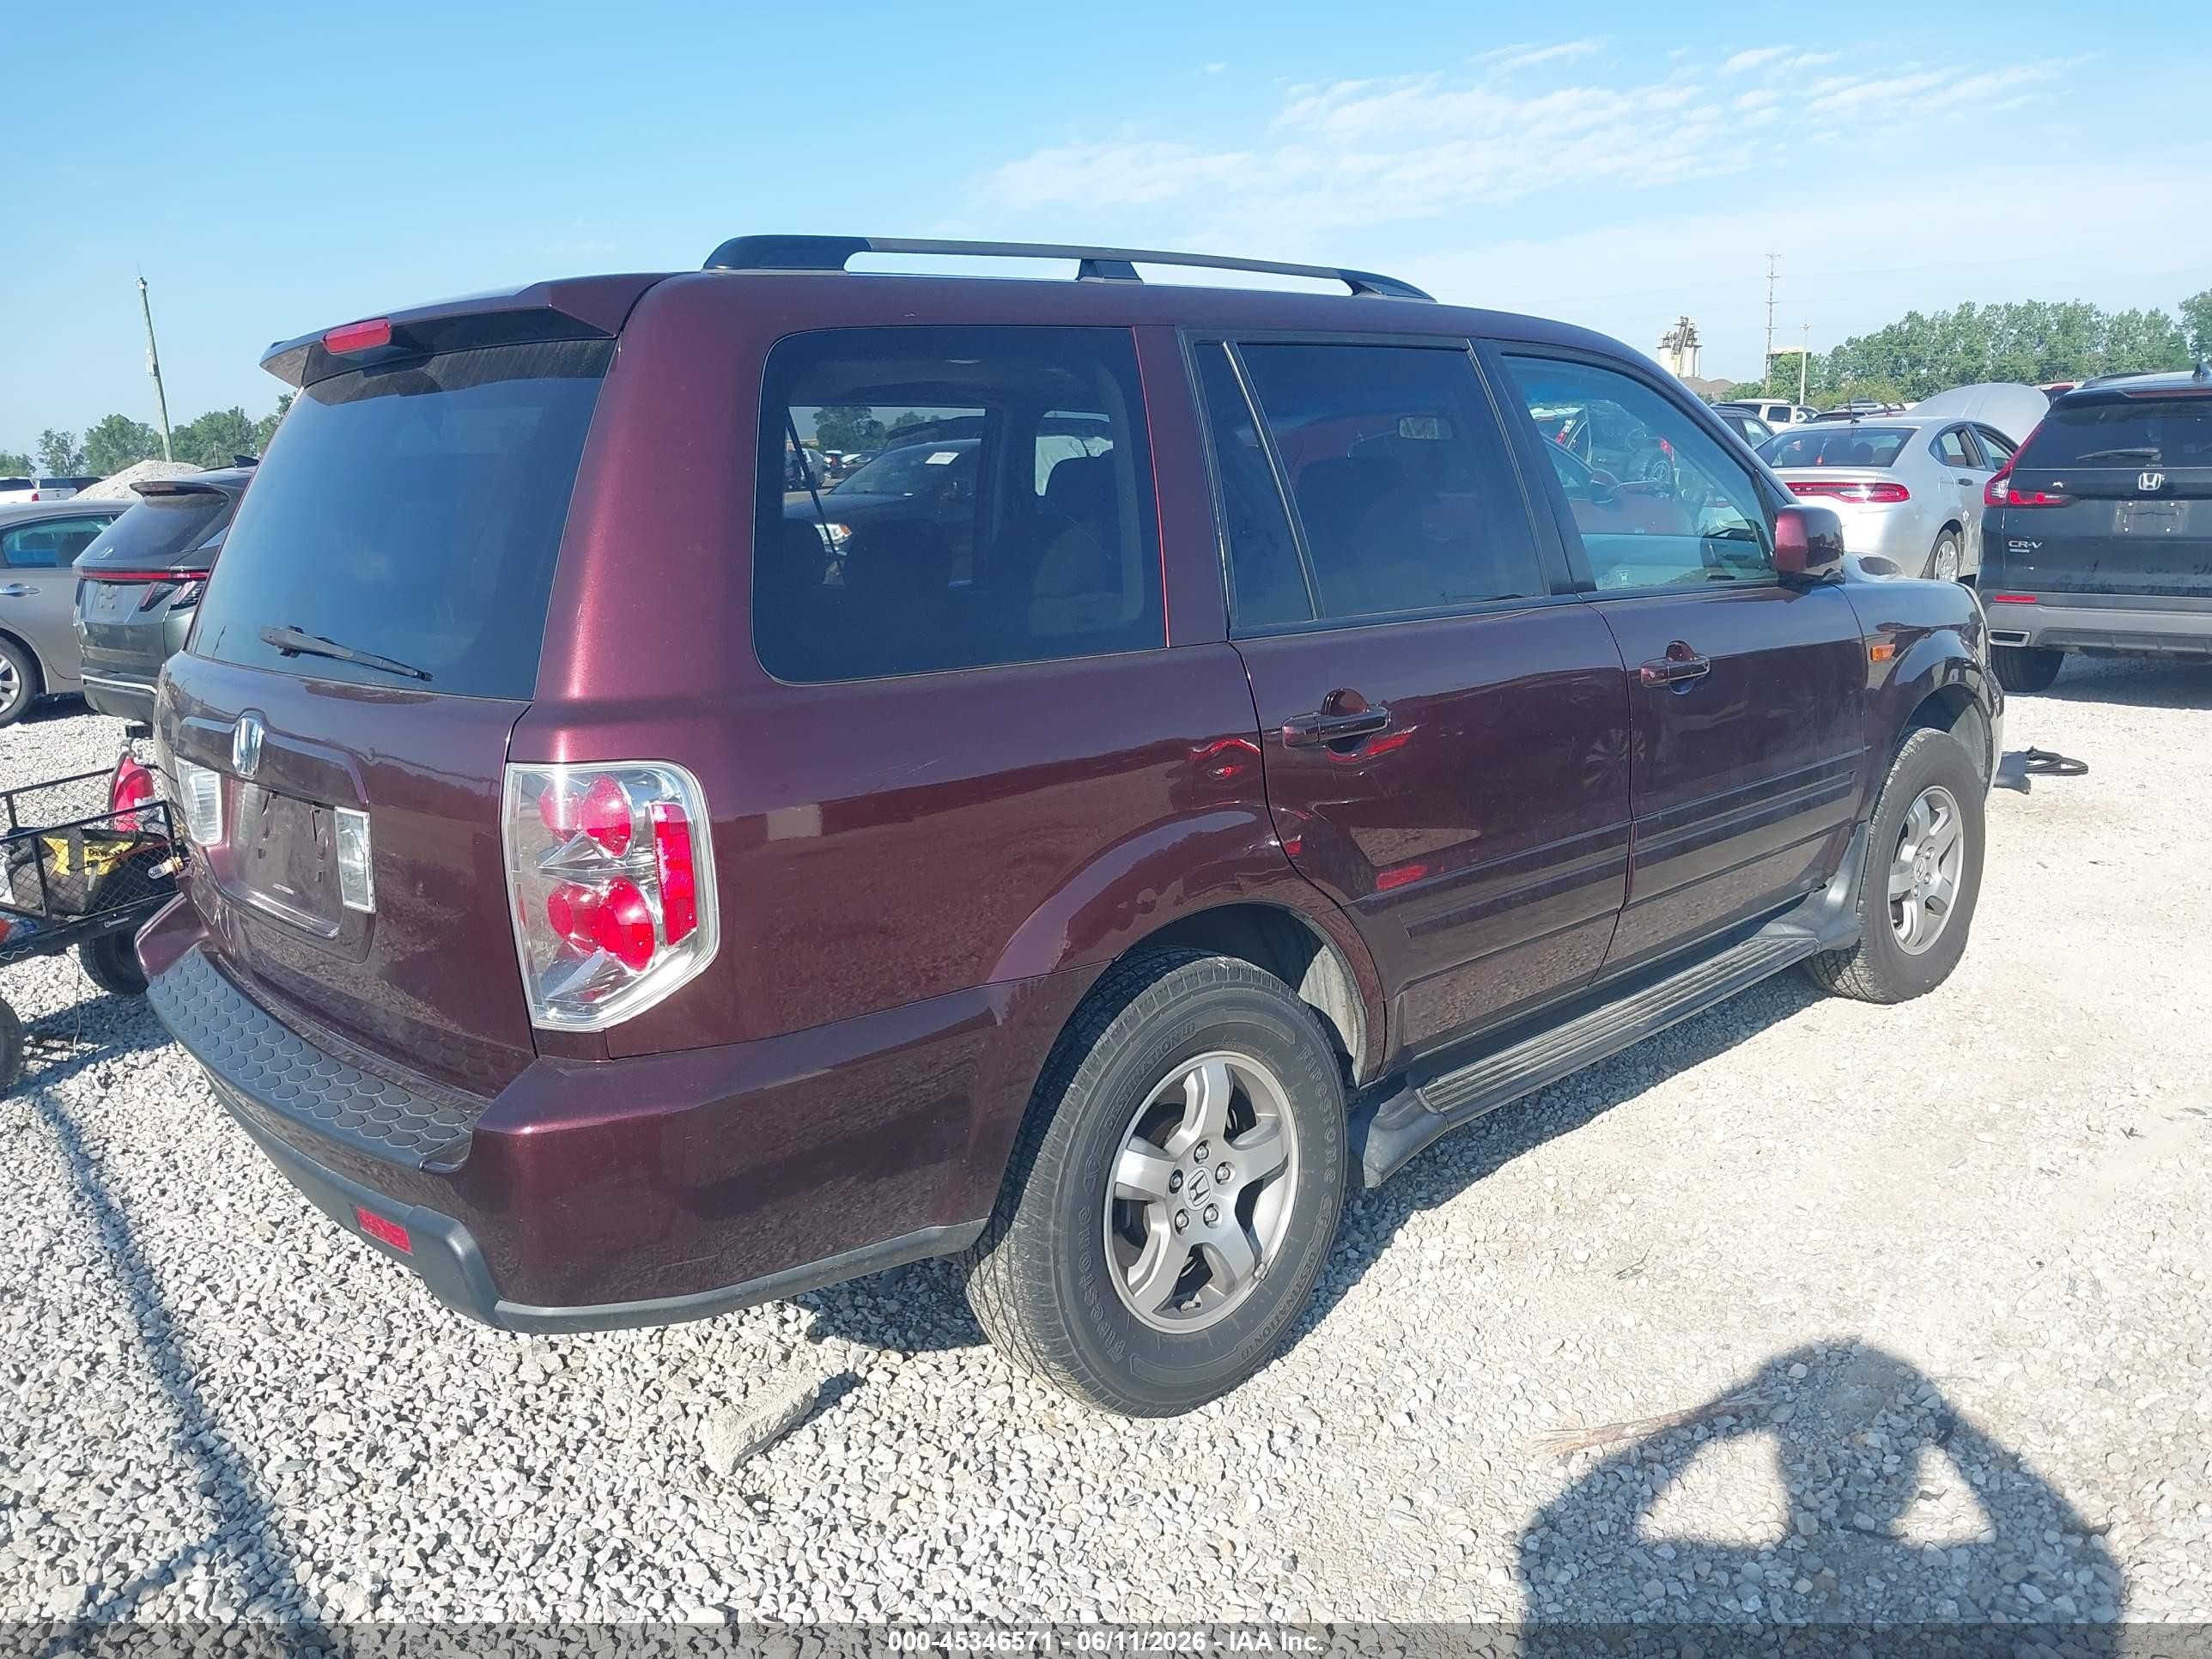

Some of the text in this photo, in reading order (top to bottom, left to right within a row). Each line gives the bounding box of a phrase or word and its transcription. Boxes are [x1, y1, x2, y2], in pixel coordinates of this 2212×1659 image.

[2008, 540, 2043, 549] CR-V
[1104, 1030, 1181, 1129] DESTINATION
[1297, 1042, 1337, 1183] Firestone
[1079, 1206, 1127, 1362] Firestone
